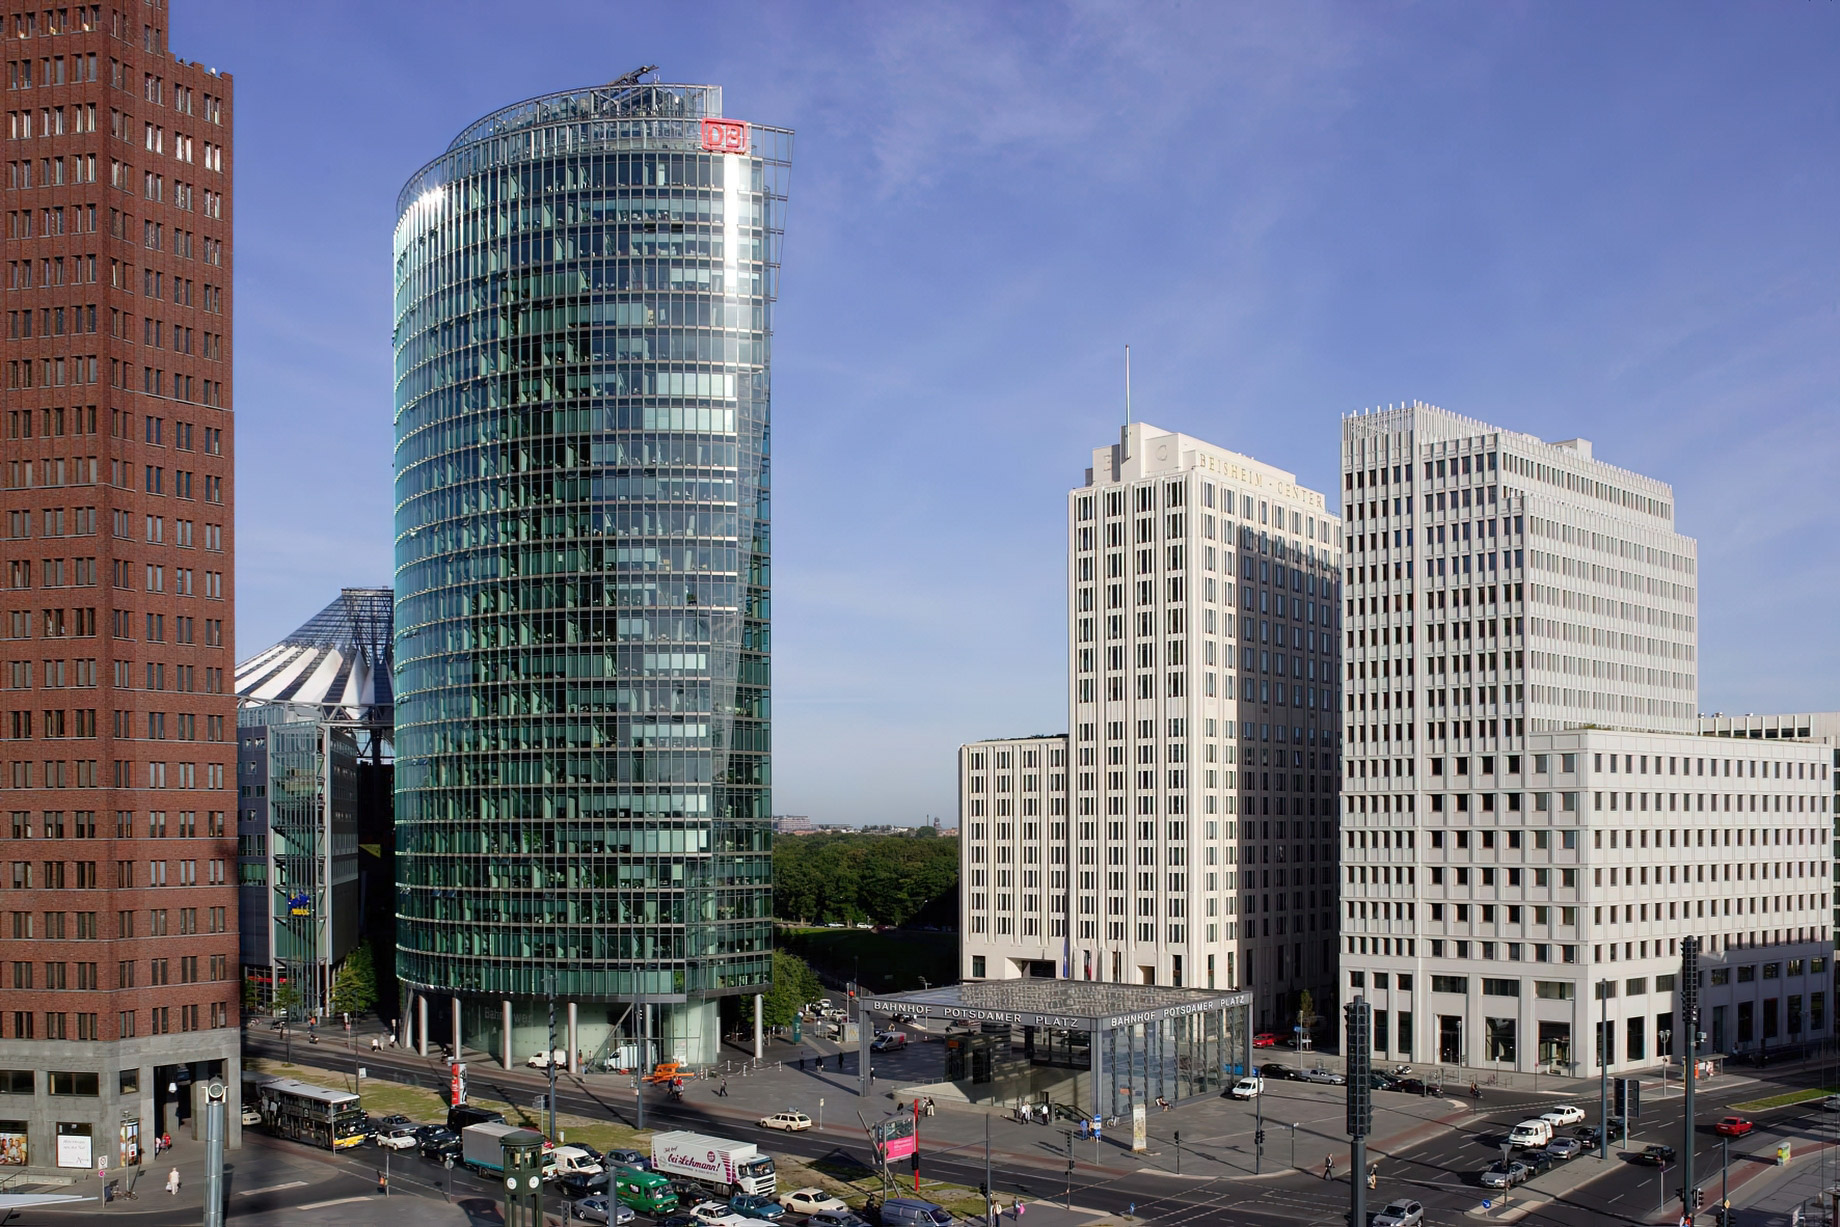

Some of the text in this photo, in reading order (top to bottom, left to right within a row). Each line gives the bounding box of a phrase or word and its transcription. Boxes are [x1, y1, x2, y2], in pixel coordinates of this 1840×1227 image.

[708, 122, 741, 148] DB
[1199, 453, 1323, 510] BEISHEIM CENTER
[874, 1001, 1079, 1028] BAHNHOF POTSDAMER PLATZ
[1111, 995, 1245, 1027] BAHNHOF POTSDAMER PLATZ
[667, 1153, 679, 1164] bei
[679, 1156, 721, 1172] Lehmann!
